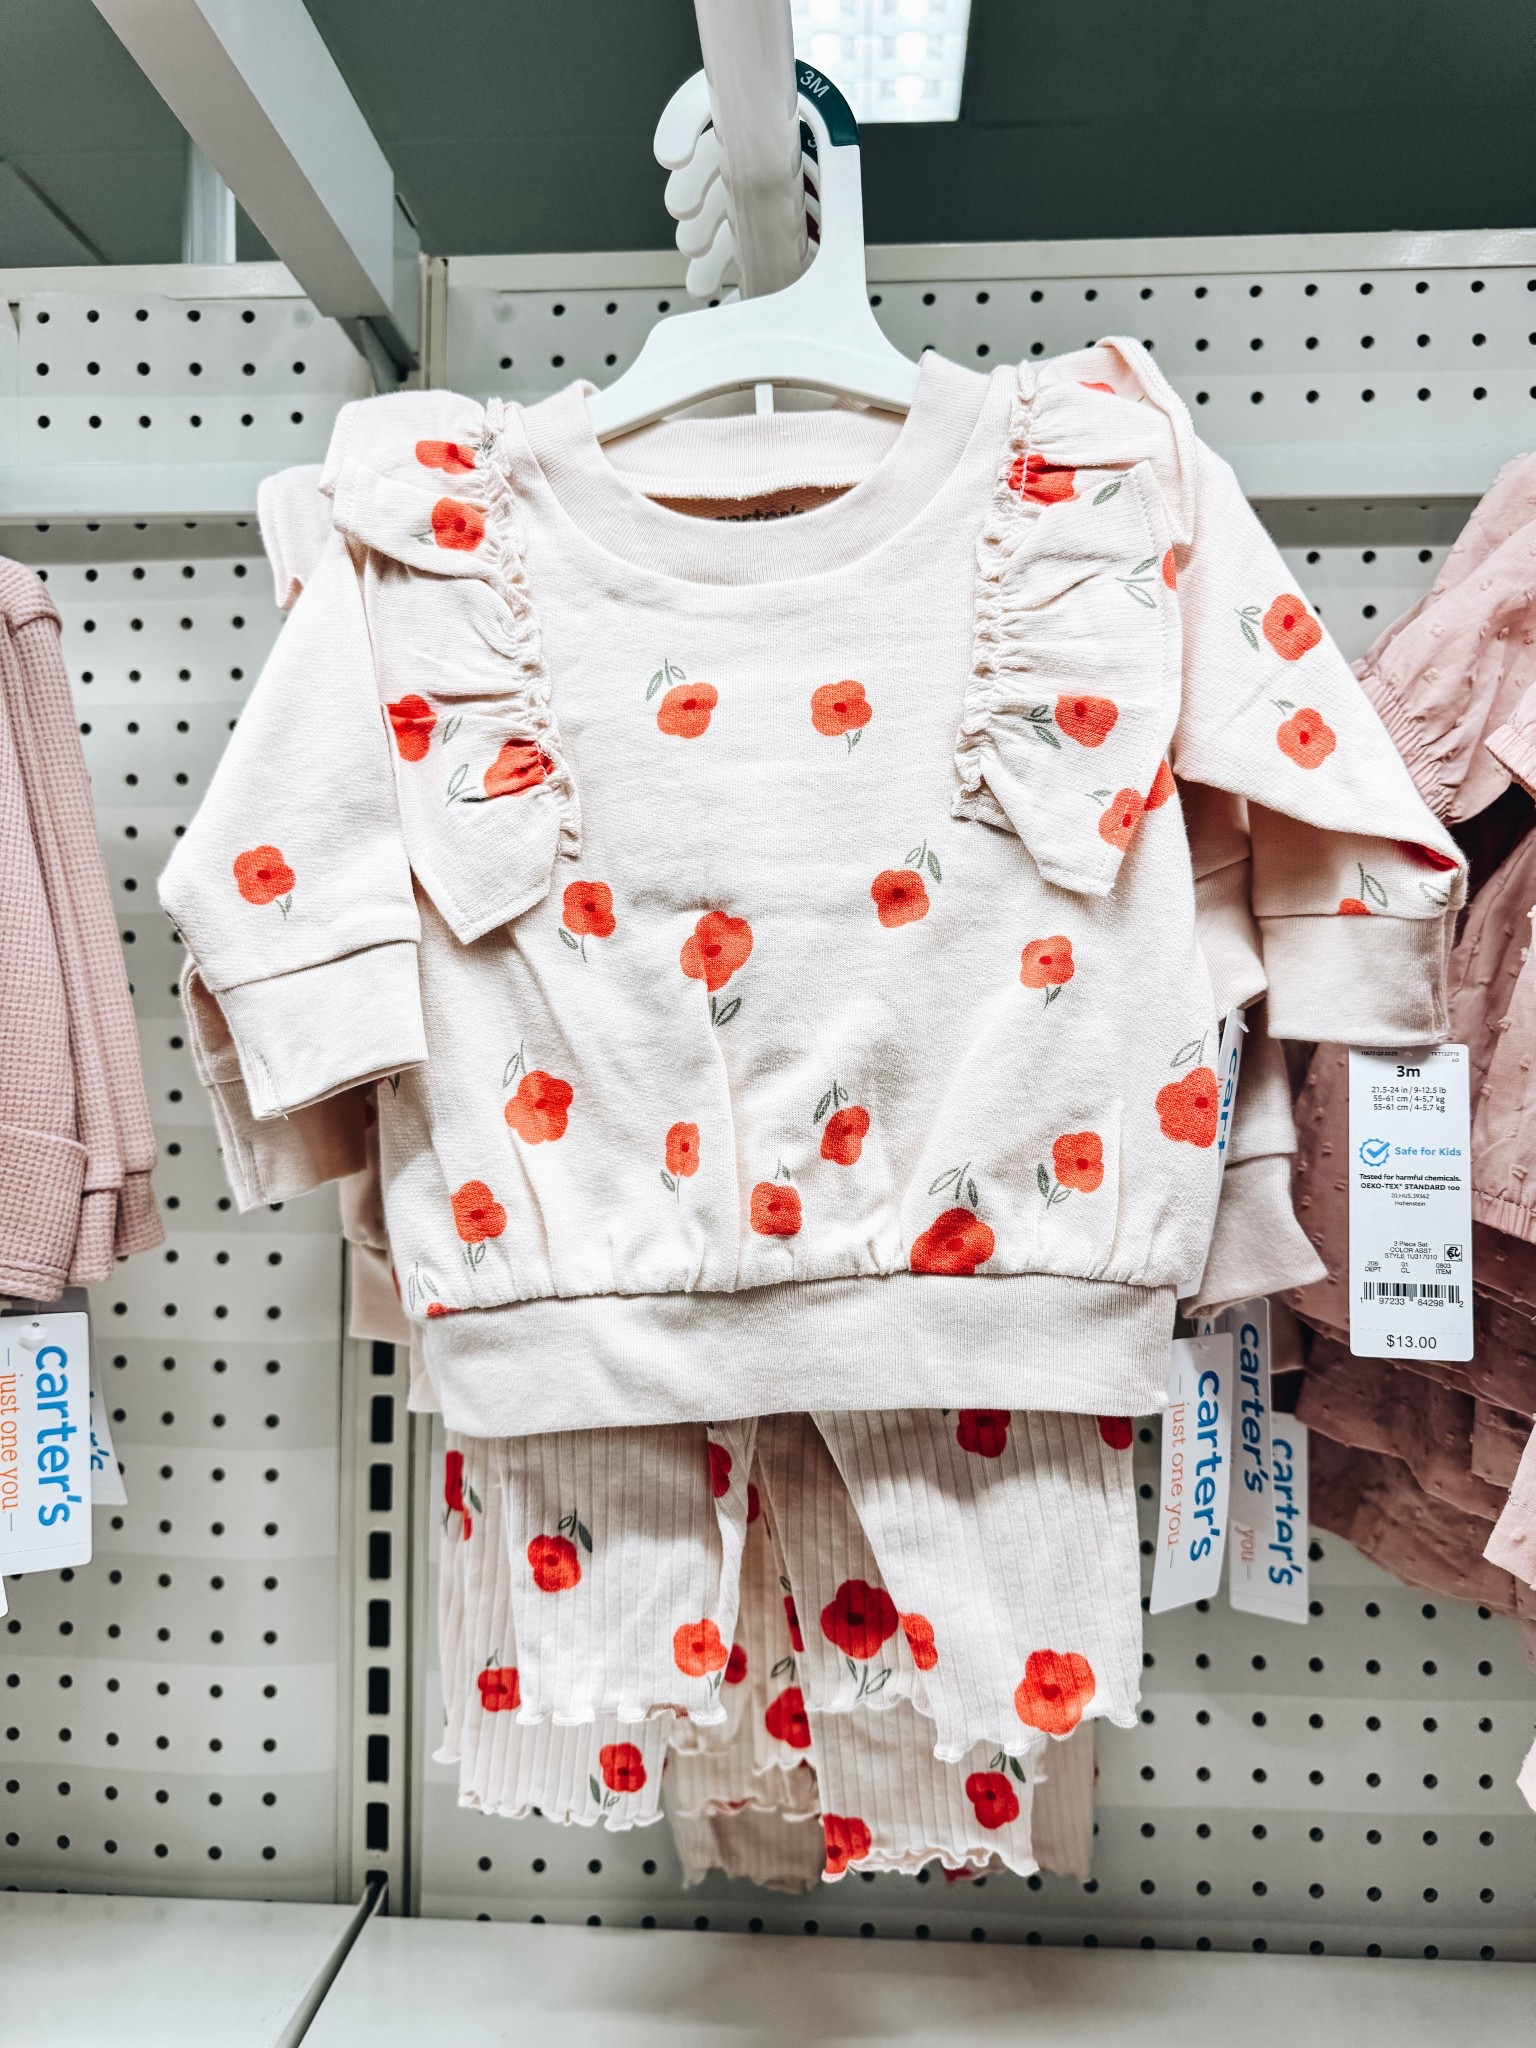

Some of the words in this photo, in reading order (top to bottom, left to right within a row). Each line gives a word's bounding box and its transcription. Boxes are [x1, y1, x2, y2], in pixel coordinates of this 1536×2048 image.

[800, 70, 830, 98] 3M
[1396, 1065, 1420, 1077] 3m
[1436, 1096, 1445, 1104] kg
[1436, 1104, 1445, 1113] kg
[1395, 1147, 1418, 1156] Safe
[1420, 1147, 1436, 1156] for
[1439, 1148, 1462, 1156] Kids
[1418, 1299, 1444, 1307] 64298
[1386, 1334, 1437, 1348] $13.00
[0, 1373, 24, 1415] just
[1239, 1322, 1269, 1494] carter's
[1, 1420, 18, 1462] one
[35, 1345, 82, 1527] carter's
[1168, 1402, 1189, 1447] just
[1171, 1452, 1184, 1496] one
[1190, 1370, 1222, 1561] carter's
